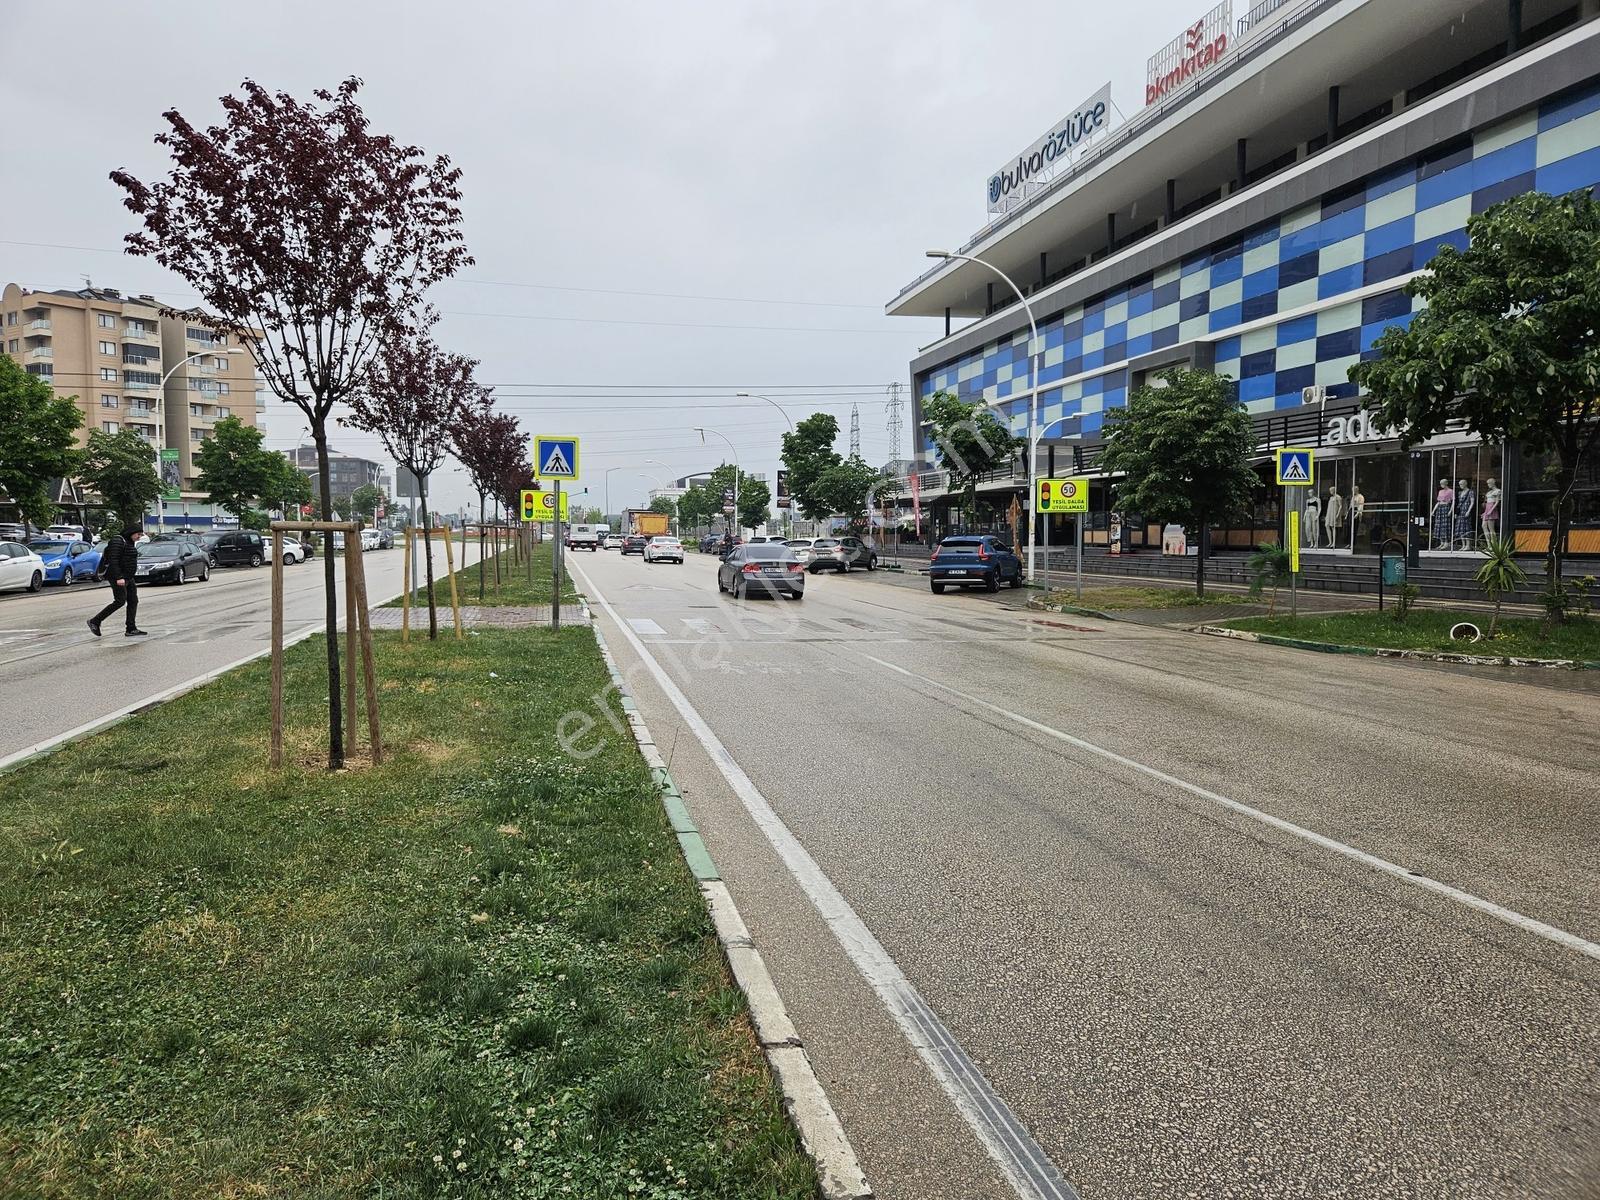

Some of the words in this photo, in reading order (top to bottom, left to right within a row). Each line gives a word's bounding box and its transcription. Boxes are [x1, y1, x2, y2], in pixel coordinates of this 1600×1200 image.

[1146, 32, 1227, 106] bkmkitap
[1001, 101, 1105, 195] bulvarözlüce
[1063, 486, 1074, 494] 50
